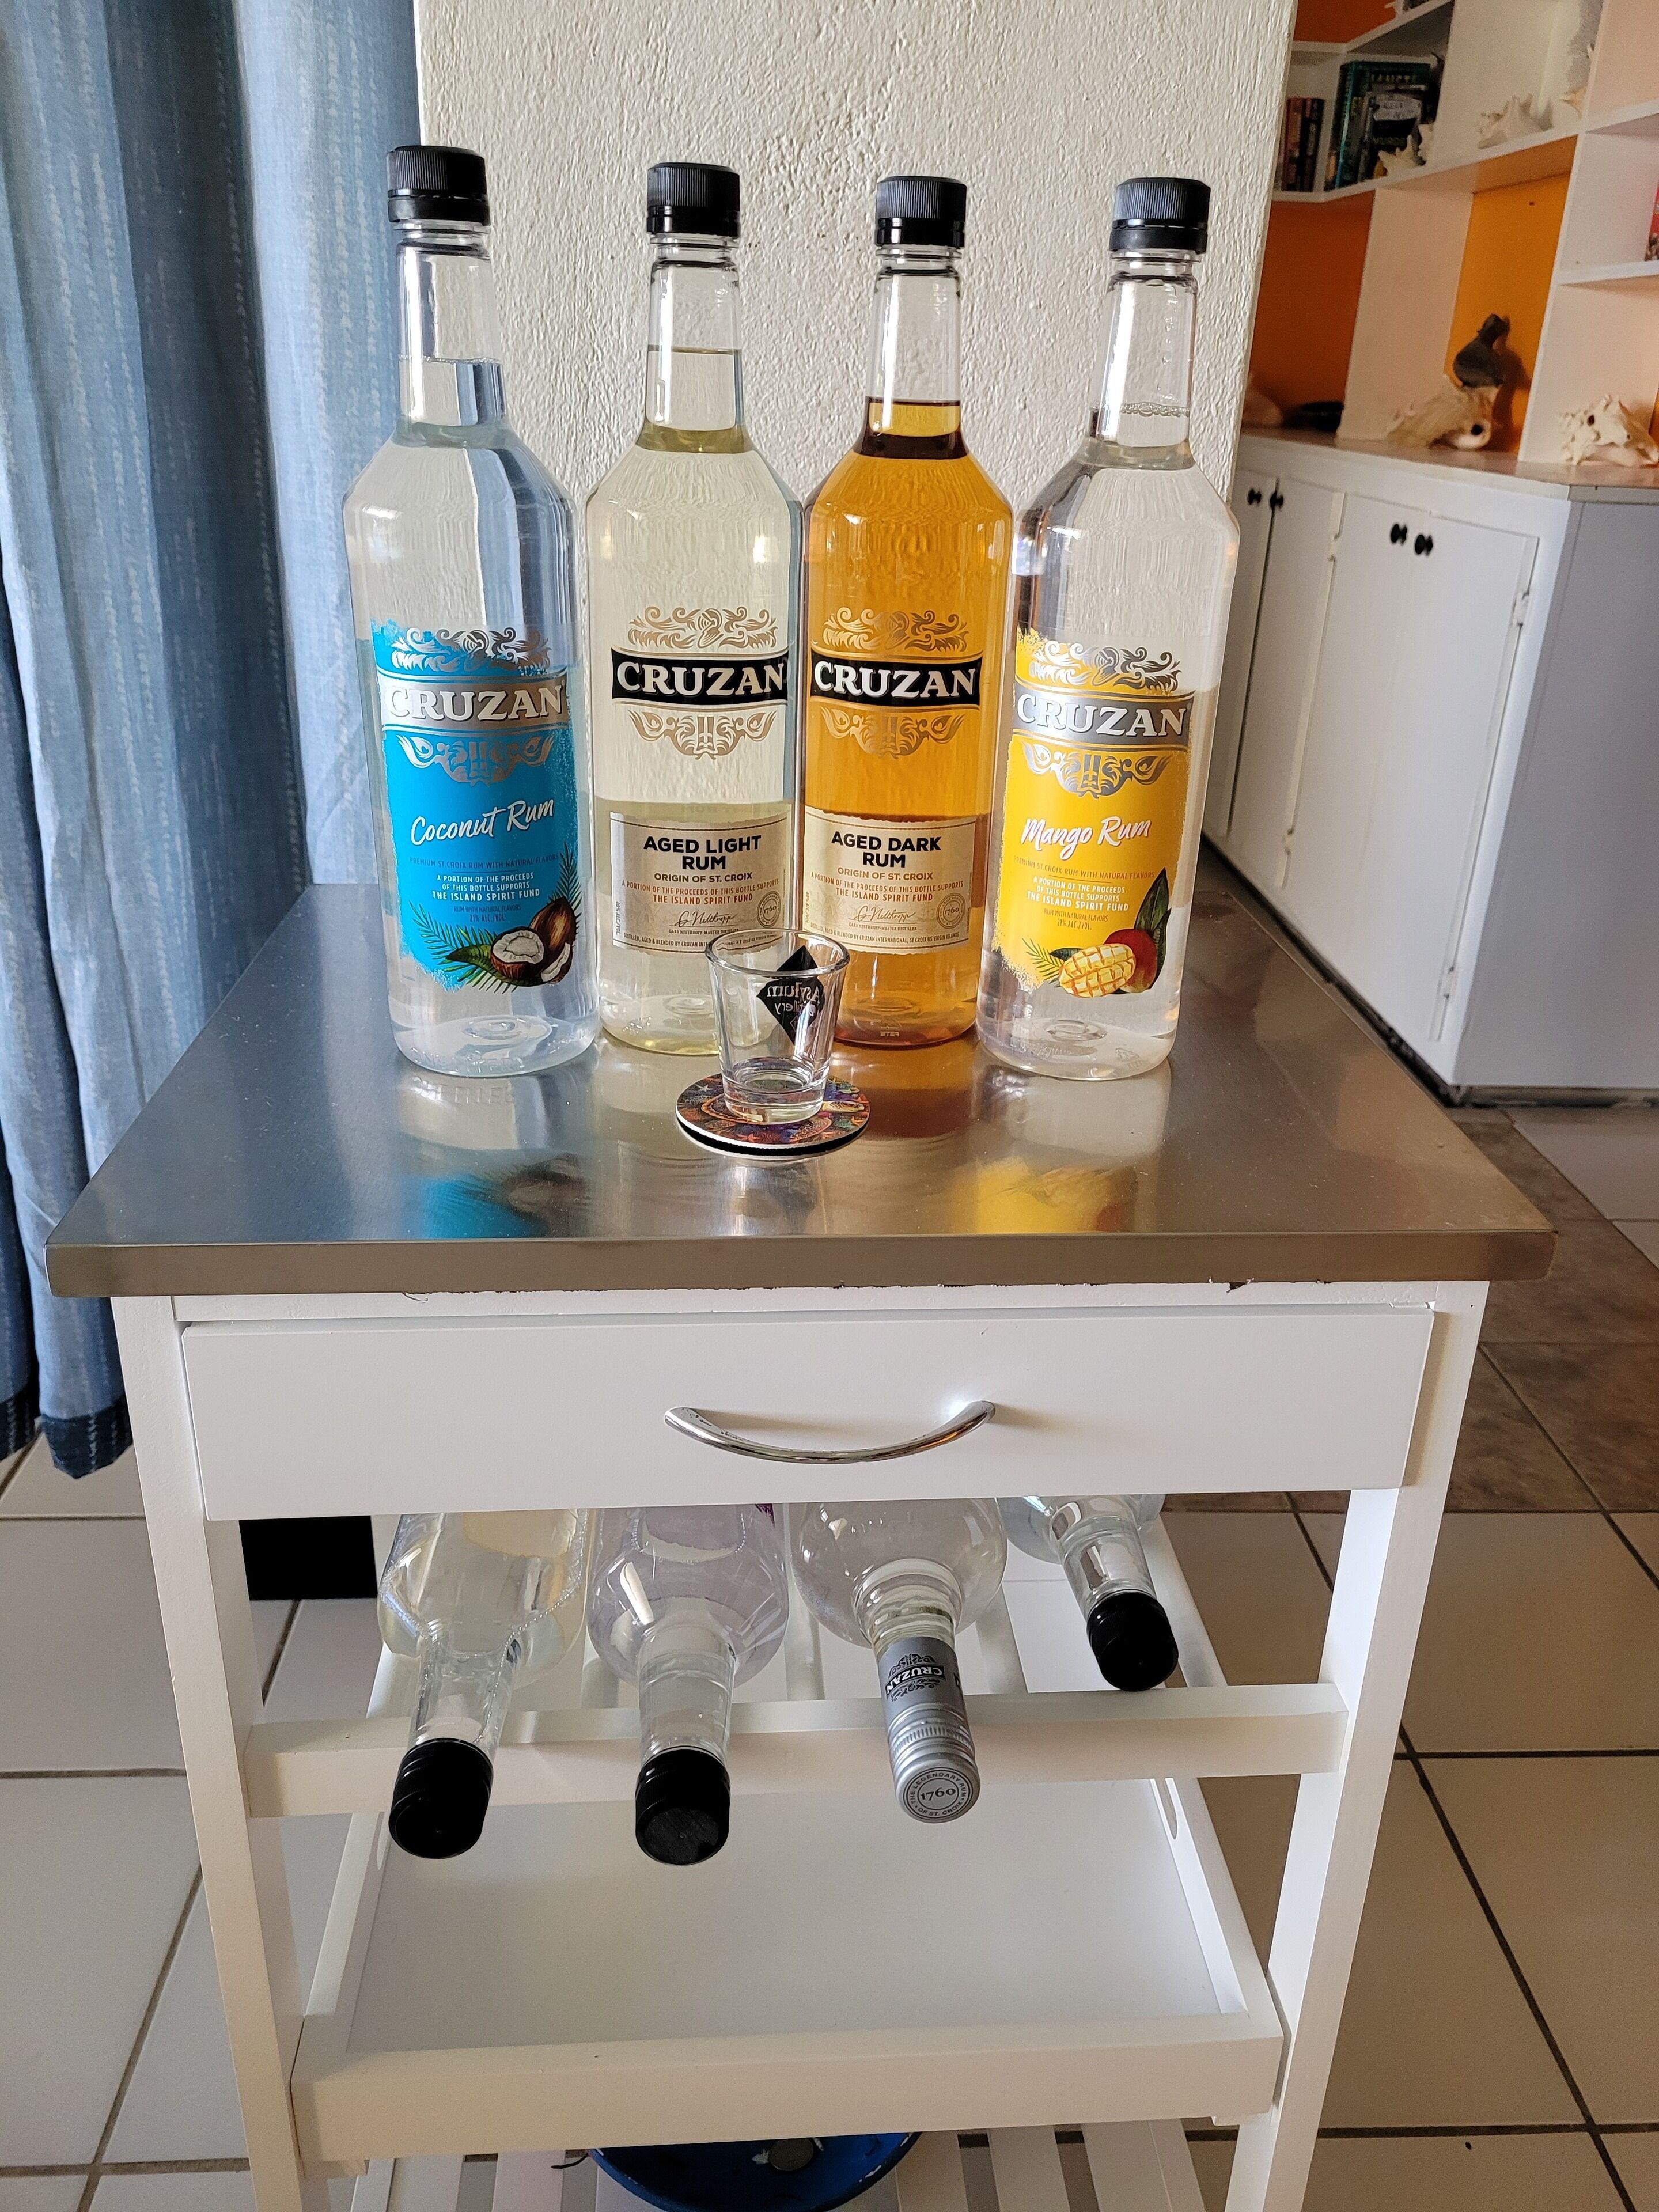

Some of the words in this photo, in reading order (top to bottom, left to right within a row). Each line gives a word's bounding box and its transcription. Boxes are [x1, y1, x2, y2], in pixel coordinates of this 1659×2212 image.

[617, 661, 784, 696] CRUZAN
[814, 661, 976, 698] CRUZAN
[385, 685, 563, 721] CRUZAN
[1017, 694, 1188, 737] CRUZAN
[411, 806, 506, 846] Coconut
[507, 799, 554, 831] Rum
[643, 836, 699, 853] AGED
[706, 835, 762, 853] LIGHT
[831, 831, 882, 850] AGED
[888, 836, 942, 851] DARK
[1021, 818, 1093, 860] Mango
[1097, 816, 1152, 846] Rum
[505, 859, 533, 867] NATURAL
[682, 855, 726, 870] RUM
[862, 852, 906, 868] RUM
[501, 873, 534, 882] PROCEEDS
[654, 873, 689, 882] ORIGIN
[724, 872, 752, 881] CROIX
[838, 867, 869, 879] ORIGIN
[872, 872, 885, 880] OF
[903, 872, 933, 881] CROIX
[1081, 870, 1097, 878] WITH
[497, 881, 529, 891] SUPPORTS
[627, 882, 650, 892] PORTION
[736, 884, 756, 893] BOTTLE
[815, 874, 834, 885] PORTION
[856, 883, 887, 892] PROCEEDS
[938, 881, 964, 891] SUPPORTS
[1039, 877, 1065, 888] PORTION
[432, 891, 447, 900] THE
[451, 893, 482, 901] ISLAND
[486, 892, 515, 901] SPIRIT
[518, 889, 540, 899] FUND
[653, 895, 667, 903] THE
[671, 896, 700, 905] ISLAND
[704, 896, 730, 905] SPIRIT
[734, 894, 753, 903] FUND
[836, 888, 849, 896] THE
[851, 890, 879, 901] ISLAND
[912, 893, 933, 902] FUND
[1027, 891, 1040, 901] THE
[1043, 894, 1071, 907] ISLAND
[1075, 900, 1103, 911] SPIRIT
[1107, 903, 1129, 911] FUND
[1046, 887, 1059, 896] THIS
[1061, 890, 1084, 900] BOTTLE
[1086, 893, 1119, 902] SUPPORTS
[764, 906, 777, 915] 1760
[945, 907, 959, 916] 1760
[1067, 912, 1087, 920] NATURAL
[887, 1666, 942, 1694] CRUZAN
[914, 1772, 960, 1789] LEGENDARY
[921, 1787, 956, 1801] 1760
